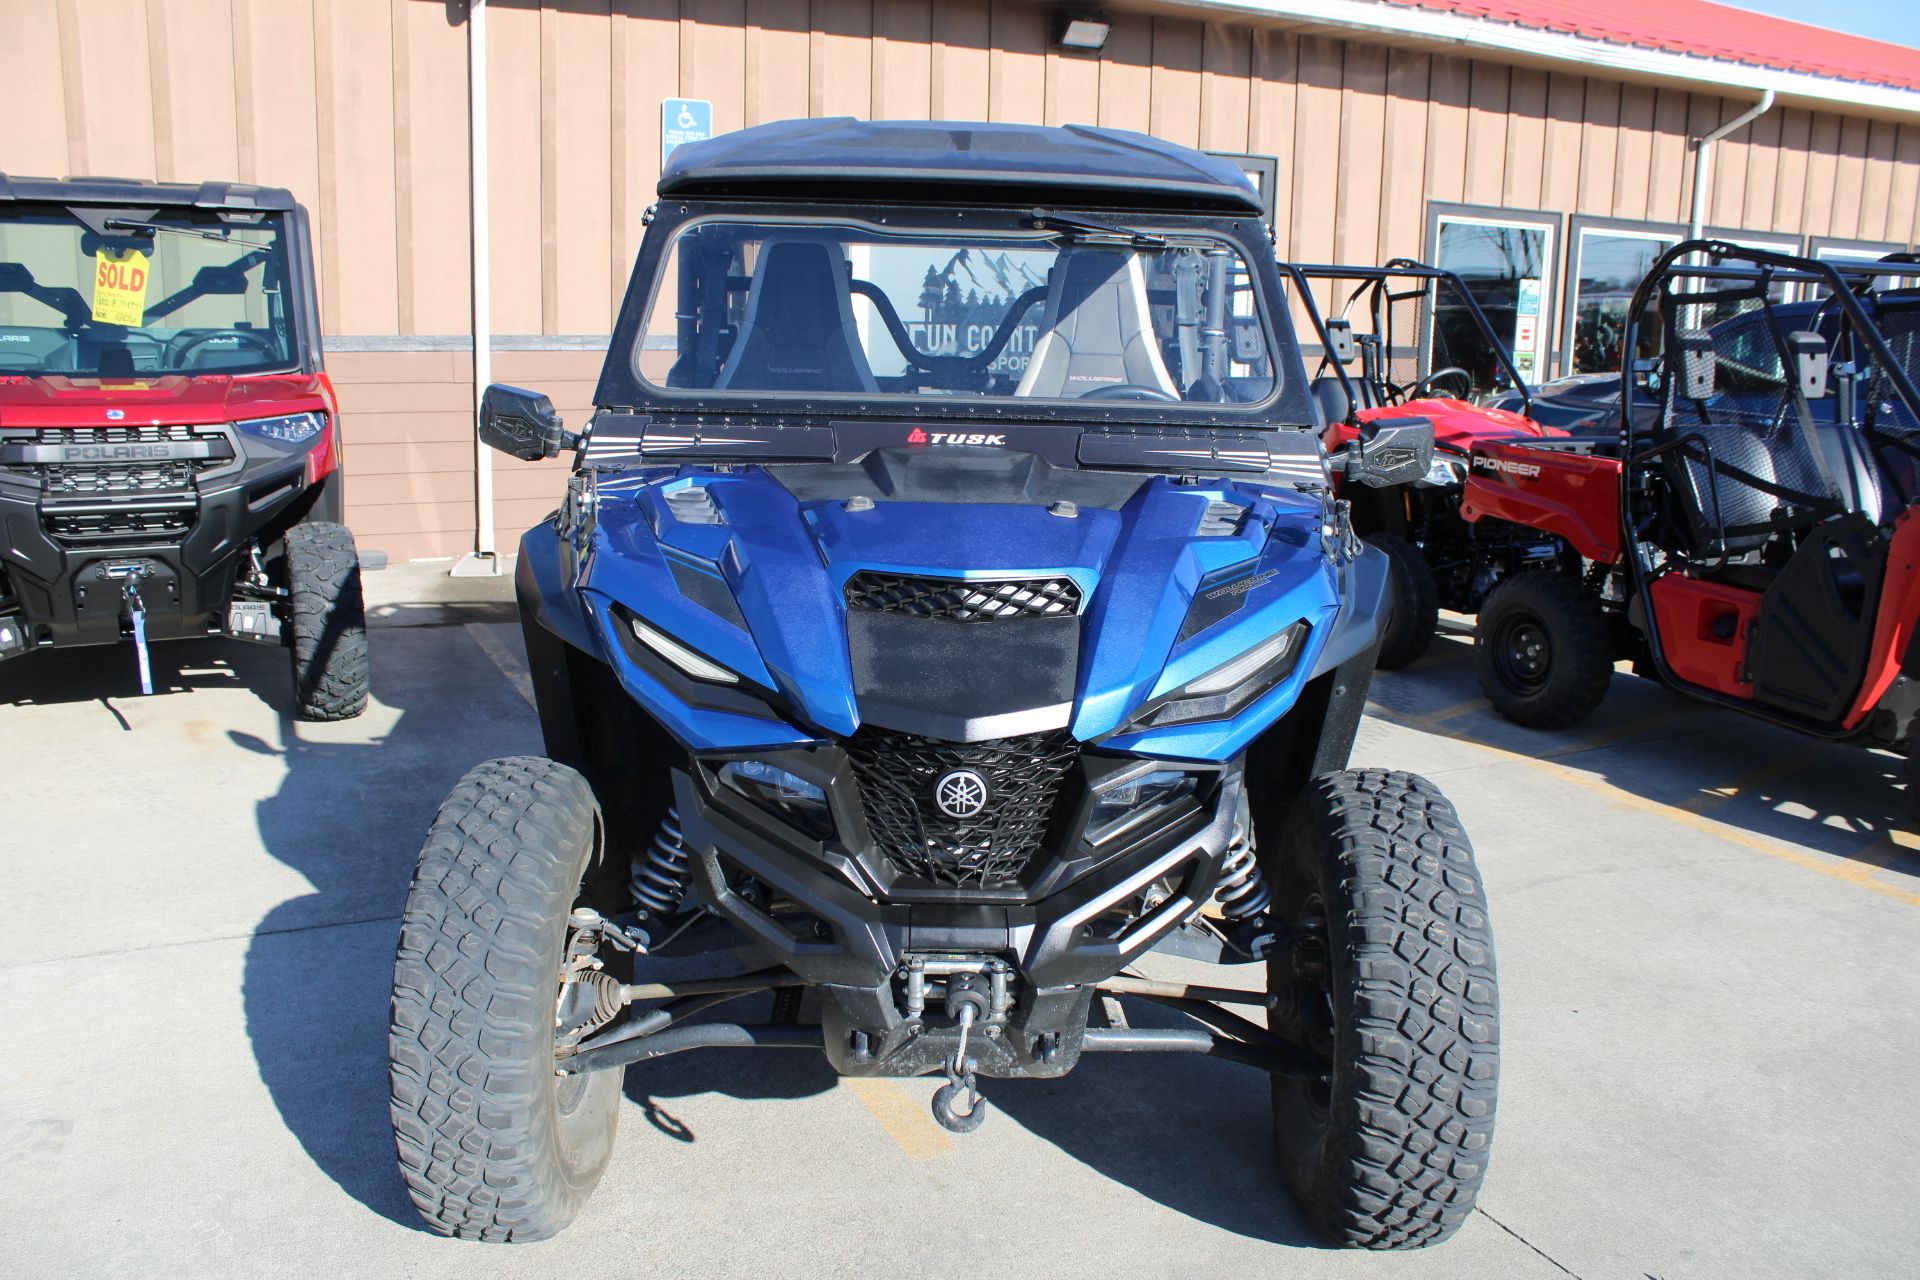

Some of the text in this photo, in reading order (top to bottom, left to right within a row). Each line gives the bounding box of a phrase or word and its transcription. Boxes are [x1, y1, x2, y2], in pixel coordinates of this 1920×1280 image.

[98, 262, 145, 292] SOLD
[931, 433, 1005, 445] TUSK
[64, 445, 169, 460] POLARIS
[1473, 456, 1541, 477] PIONEER
